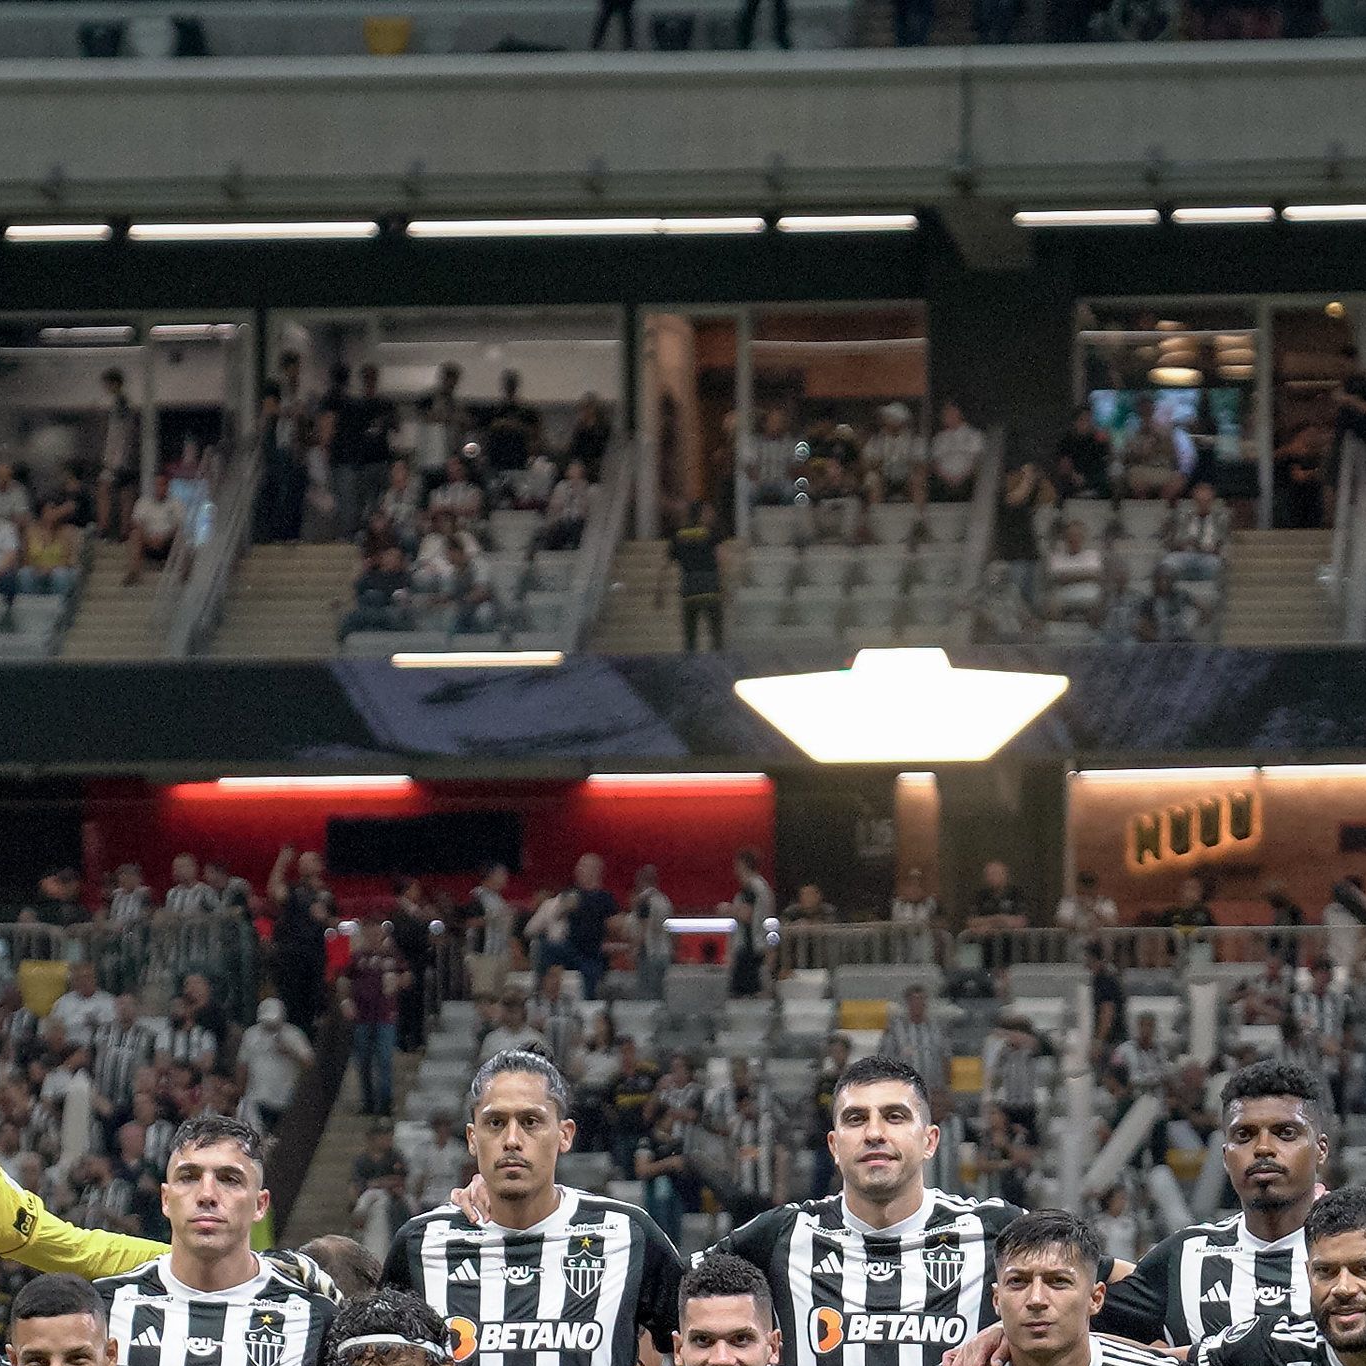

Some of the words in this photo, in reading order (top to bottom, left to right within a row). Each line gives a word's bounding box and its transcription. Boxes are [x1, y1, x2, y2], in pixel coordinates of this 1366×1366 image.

[567, 1258, 602, 1268] CAM
[926, 1251, 962, 1262] CAM
[847, 1314, 966, 1344] BETANO
[247, 1332, 282, 1345] CAM
[480, 1321, 603, 1351] BETANO
